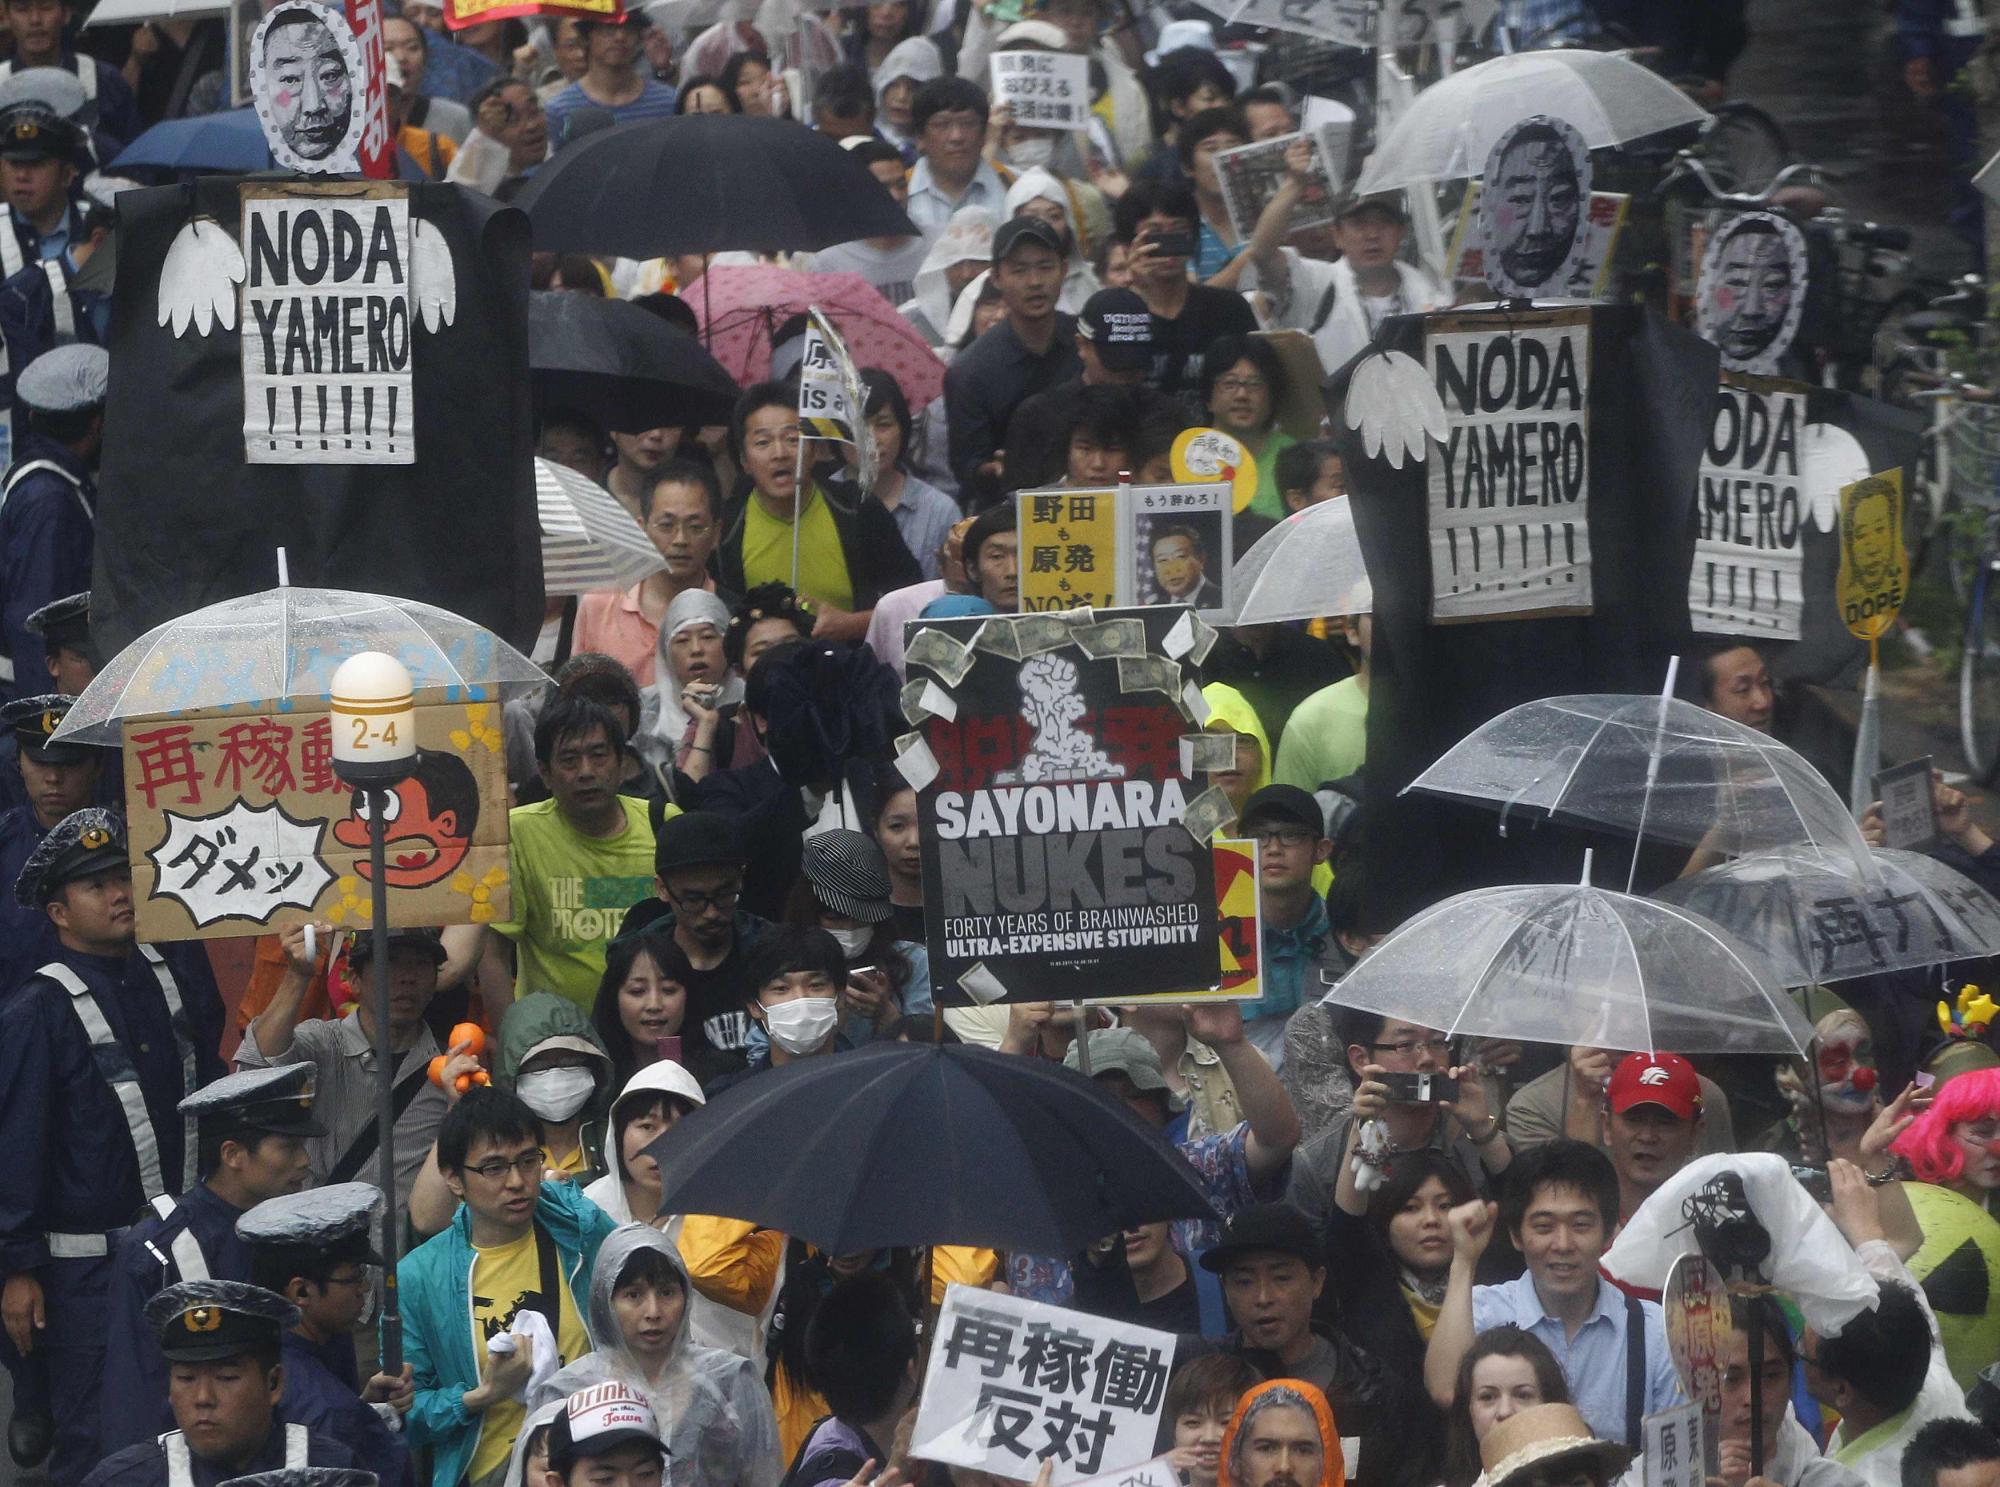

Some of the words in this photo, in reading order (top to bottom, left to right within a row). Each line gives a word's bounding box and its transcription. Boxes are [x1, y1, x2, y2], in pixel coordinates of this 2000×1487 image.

[250, 206, 402, 287] NODA
[251, 295, 409, 376] YAMERO
[802, 383, 827, 410] is
[1435, 335, 1581, 415] NODA
[1706, 392, 1798, 476] ODA
[1436, 422, 1584, 508] YAMERO
[1033, 495, 1096, 524] 野田
[1058, 527, 1070, 541] も
[1703, 477, 1798, 549] MERO
[1030, 544, 1096, 574] 原発
[1059, 577, 1072, 591] も
[1845, 588, 1901, 625] DOPE
[351, 717, 398, 750] 2-4
[935, 778, 1187, 840] SAYONARA
[167, 825, 303, 895] ダメッ
[938, 827, 1196, 917] NUKES
[547, 876, 585, 909] THE
[945, 914, 993, 939] FORTY
[997, 912, 1048, 935] YEARS
[1054, 910, 1074, 932] OF
[1079, 903, 1198, 931] BRAINWASHED
[946, 930, 1104, 958] ULTRA-EXPENSIVE
[1108, 924, 1199, 949] STUPIDITY
[943, 1301, 1169, 1416] 再稼働
[602, 1412, 643, 1427] Town
[970, 1382, 1116, 1475] 反対
